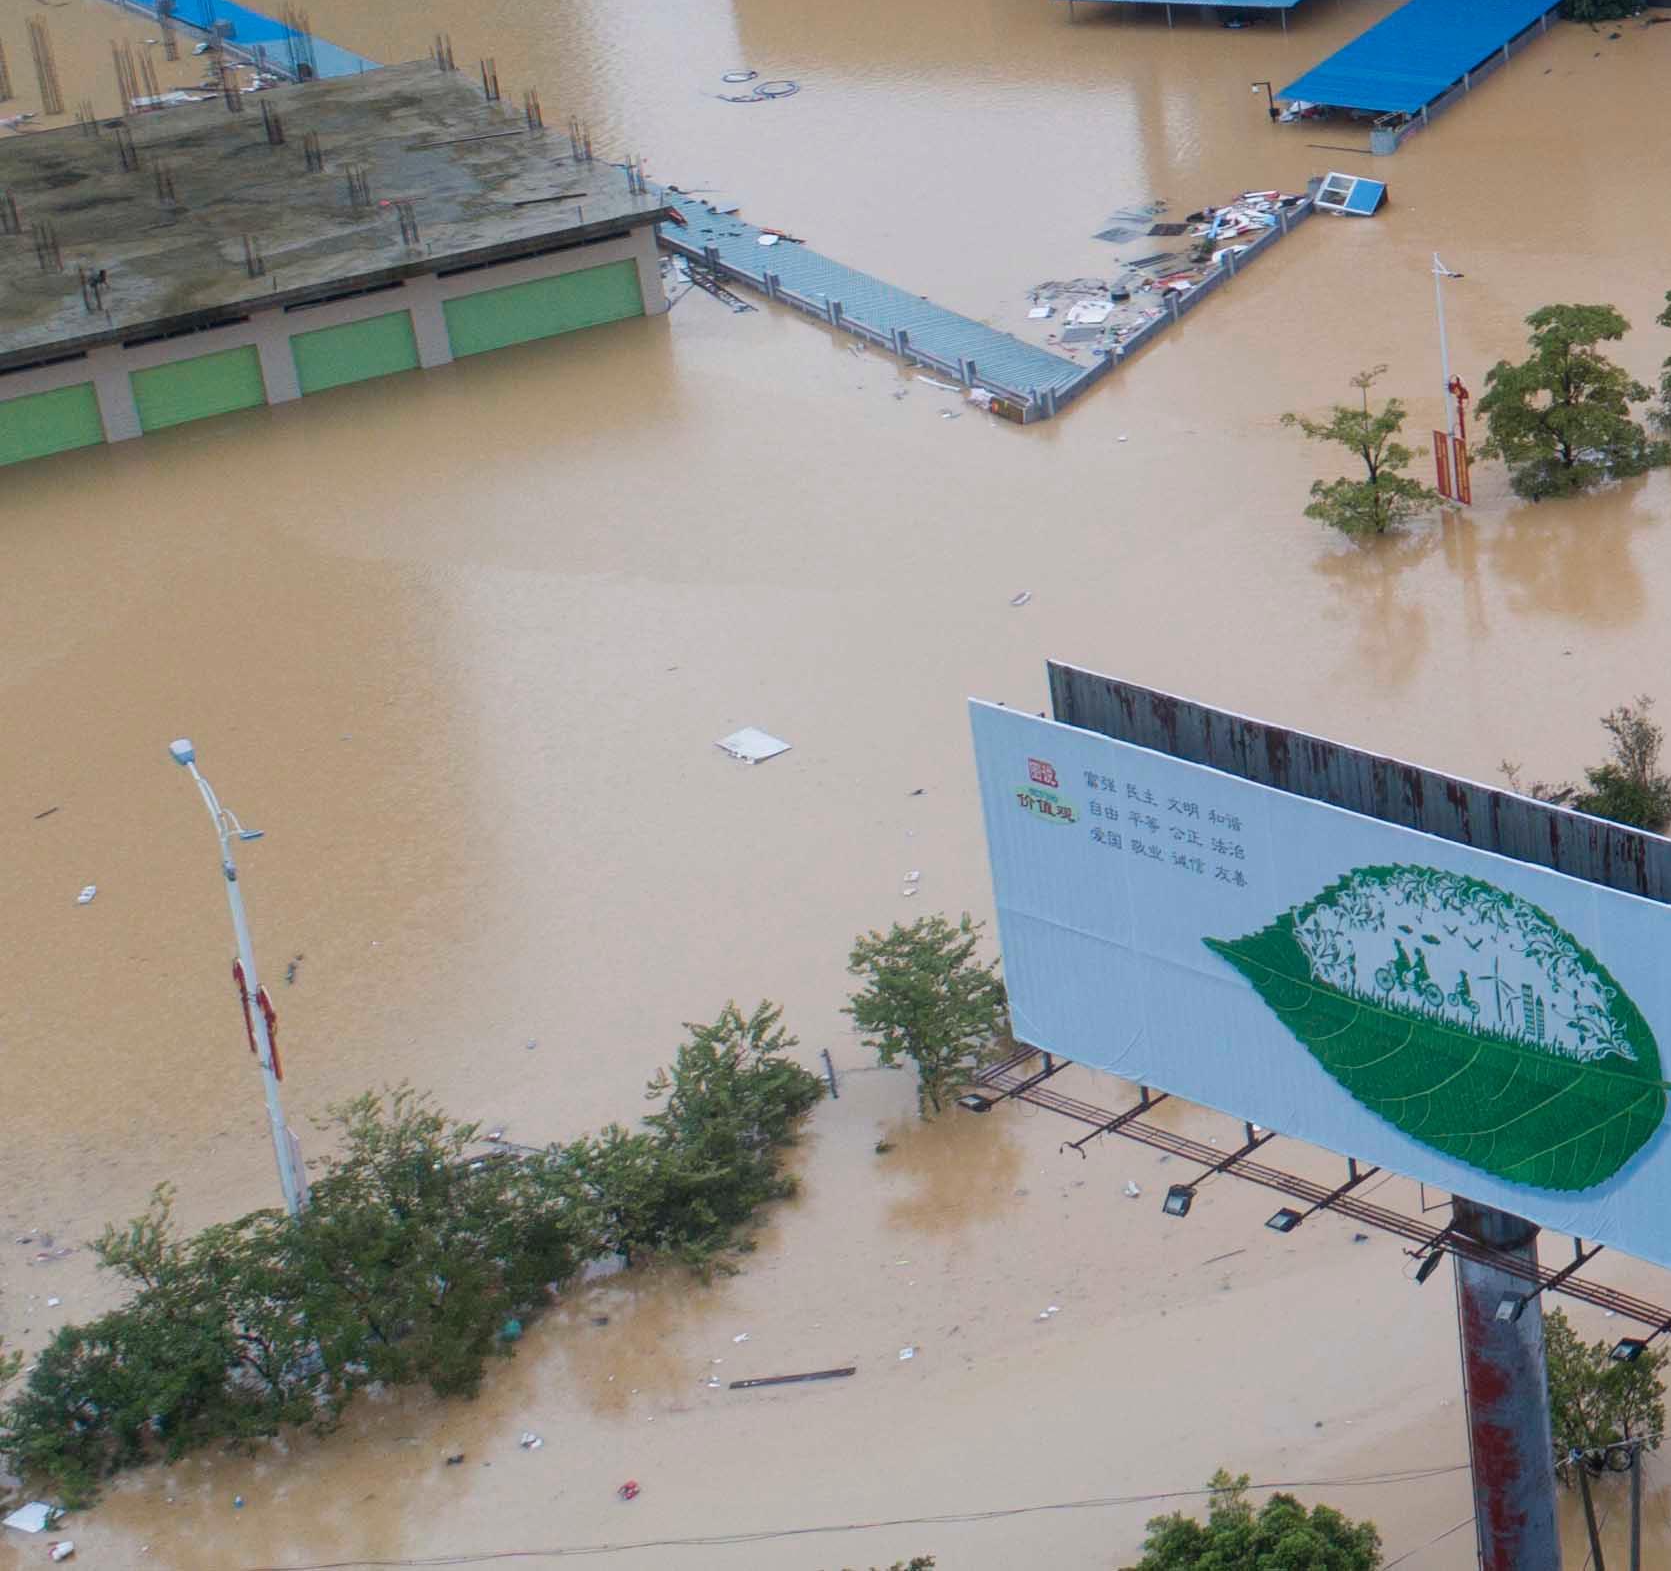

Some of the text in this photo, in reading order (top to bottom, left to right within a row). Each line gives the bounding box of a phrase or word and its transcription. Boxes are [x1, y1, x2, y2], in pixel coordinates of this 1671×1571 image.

[1016, 793, 1076, 823] 价值观
[1083, 770, 1243, 832] 富强 民主 文明 和谐
[1089, 799, 1246, 861] 自由 平等 公正 法治
[1090, 826, 1248, 888] 爱国 敬业 诚信 友善
